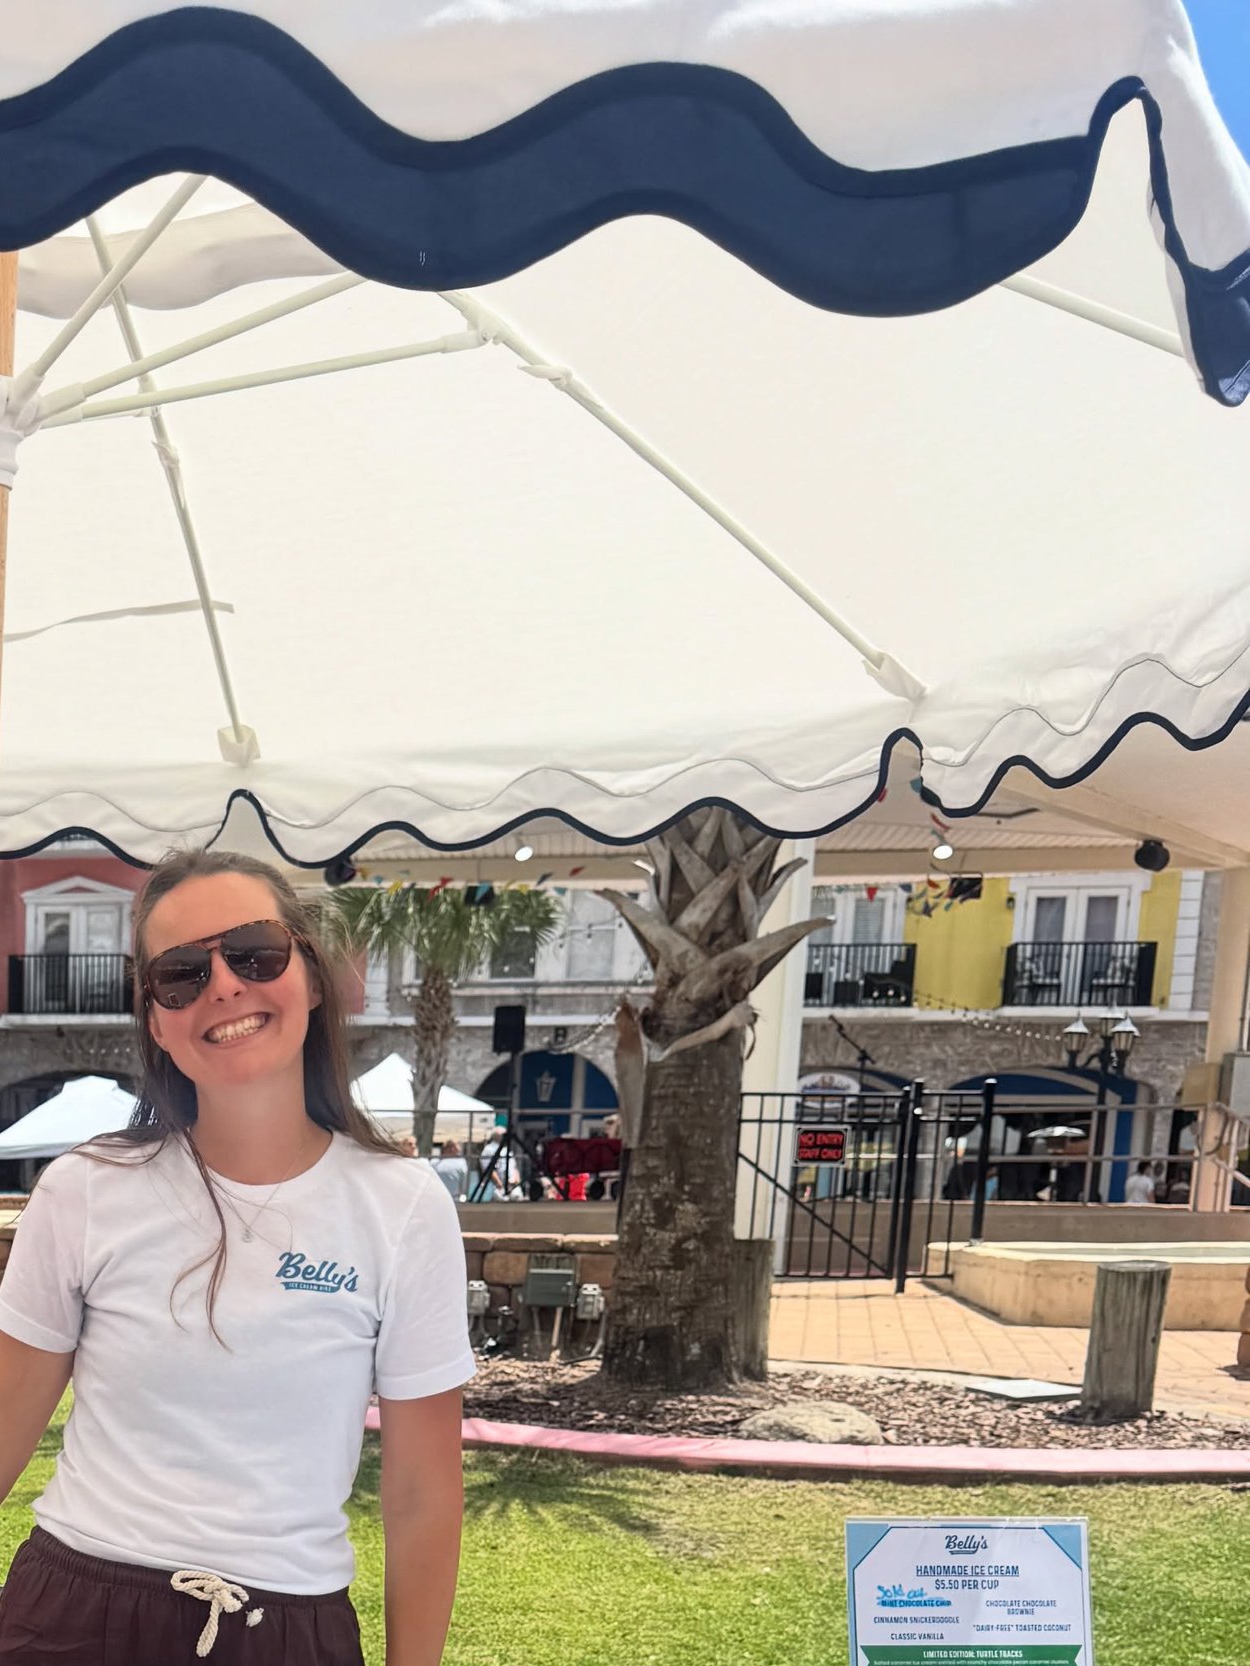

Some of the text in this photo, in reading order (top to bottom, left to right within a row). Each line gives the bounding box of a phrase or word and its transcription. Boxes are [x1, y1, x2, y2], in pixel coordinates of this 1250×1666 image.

[799, 1133, 844, 1146] NO ENTRY
[275, 1251, 359, 1293] Belly's
[945, 1535, 988, 1555] Belly's
[916, 1565, 1020, 1577] HANDMADE ICE CREAM
[935, 1579, 1000, 1590] $5.50 PER CUP
[985, 1600, 1057, 1608] CHOCOLATE CHOCOLATE
[873, 1616, 959, 1624] CINNAMON SNICKERDOODLE
[1016, 1624, 1042, 1632] TOASTED
[1043, 1624, 1071, 1632] COCONUT
[923, 1650, 948, 1658] LIMITED
[976, 1650, 999, 1658] TURTLE
[1000, 1650, 1023, 1658] TRACKS
